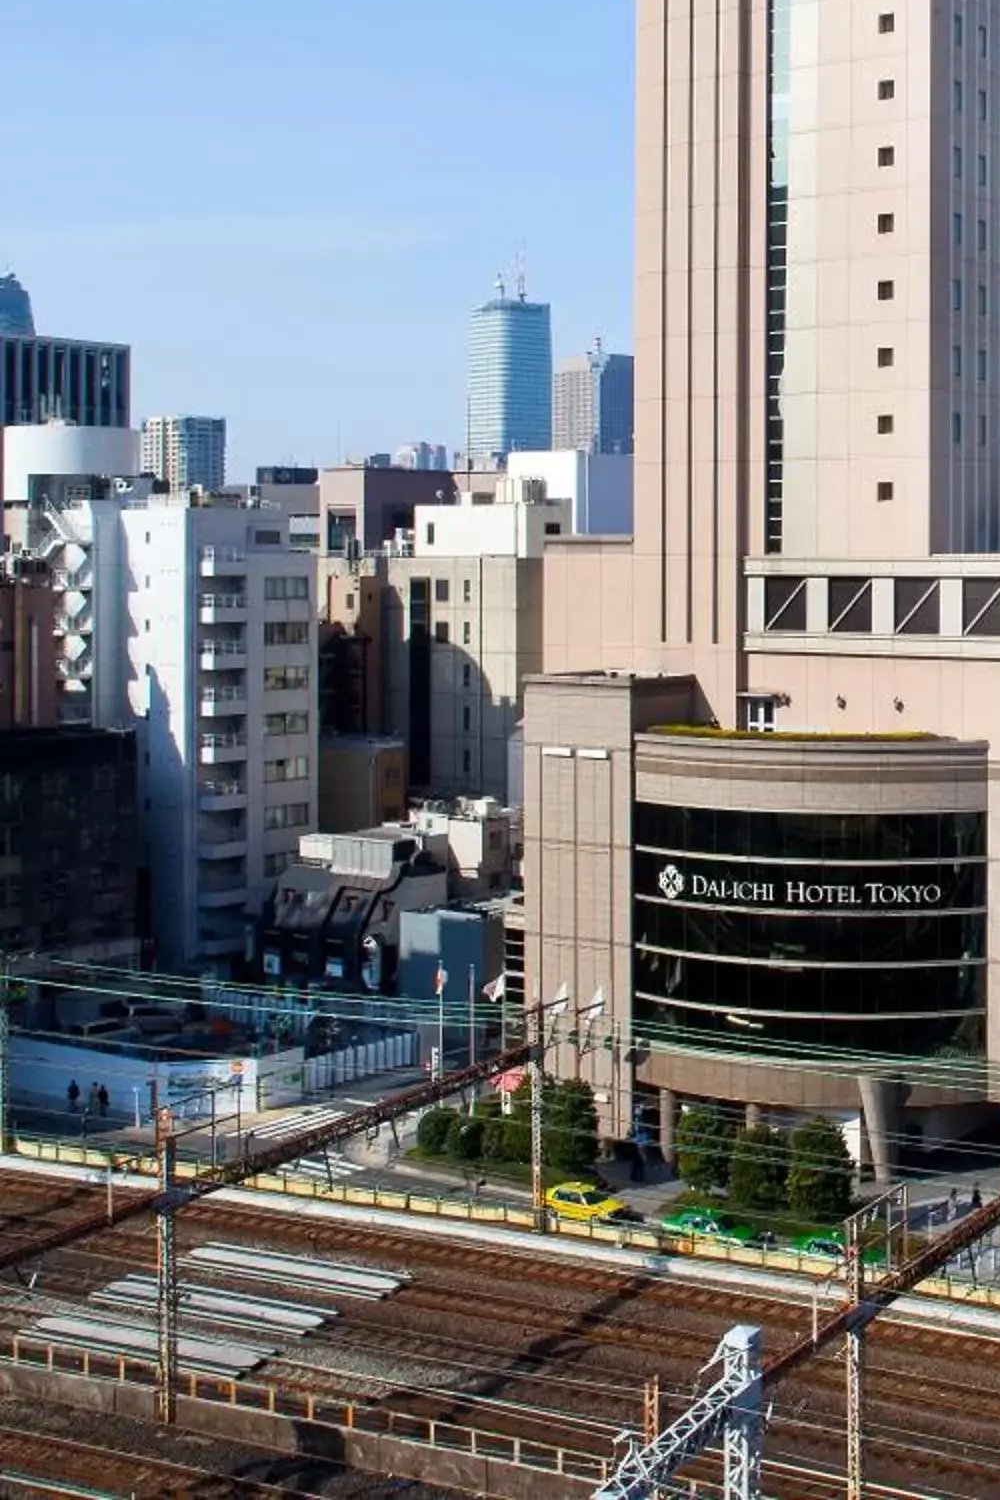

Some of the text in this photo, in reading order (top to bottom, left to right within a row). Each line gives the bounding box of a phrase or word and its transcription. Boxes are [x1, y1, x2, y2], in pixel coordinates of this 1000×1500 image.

[692, 875, 941, 903] DAI-ICHI HOTEL TOKYO
